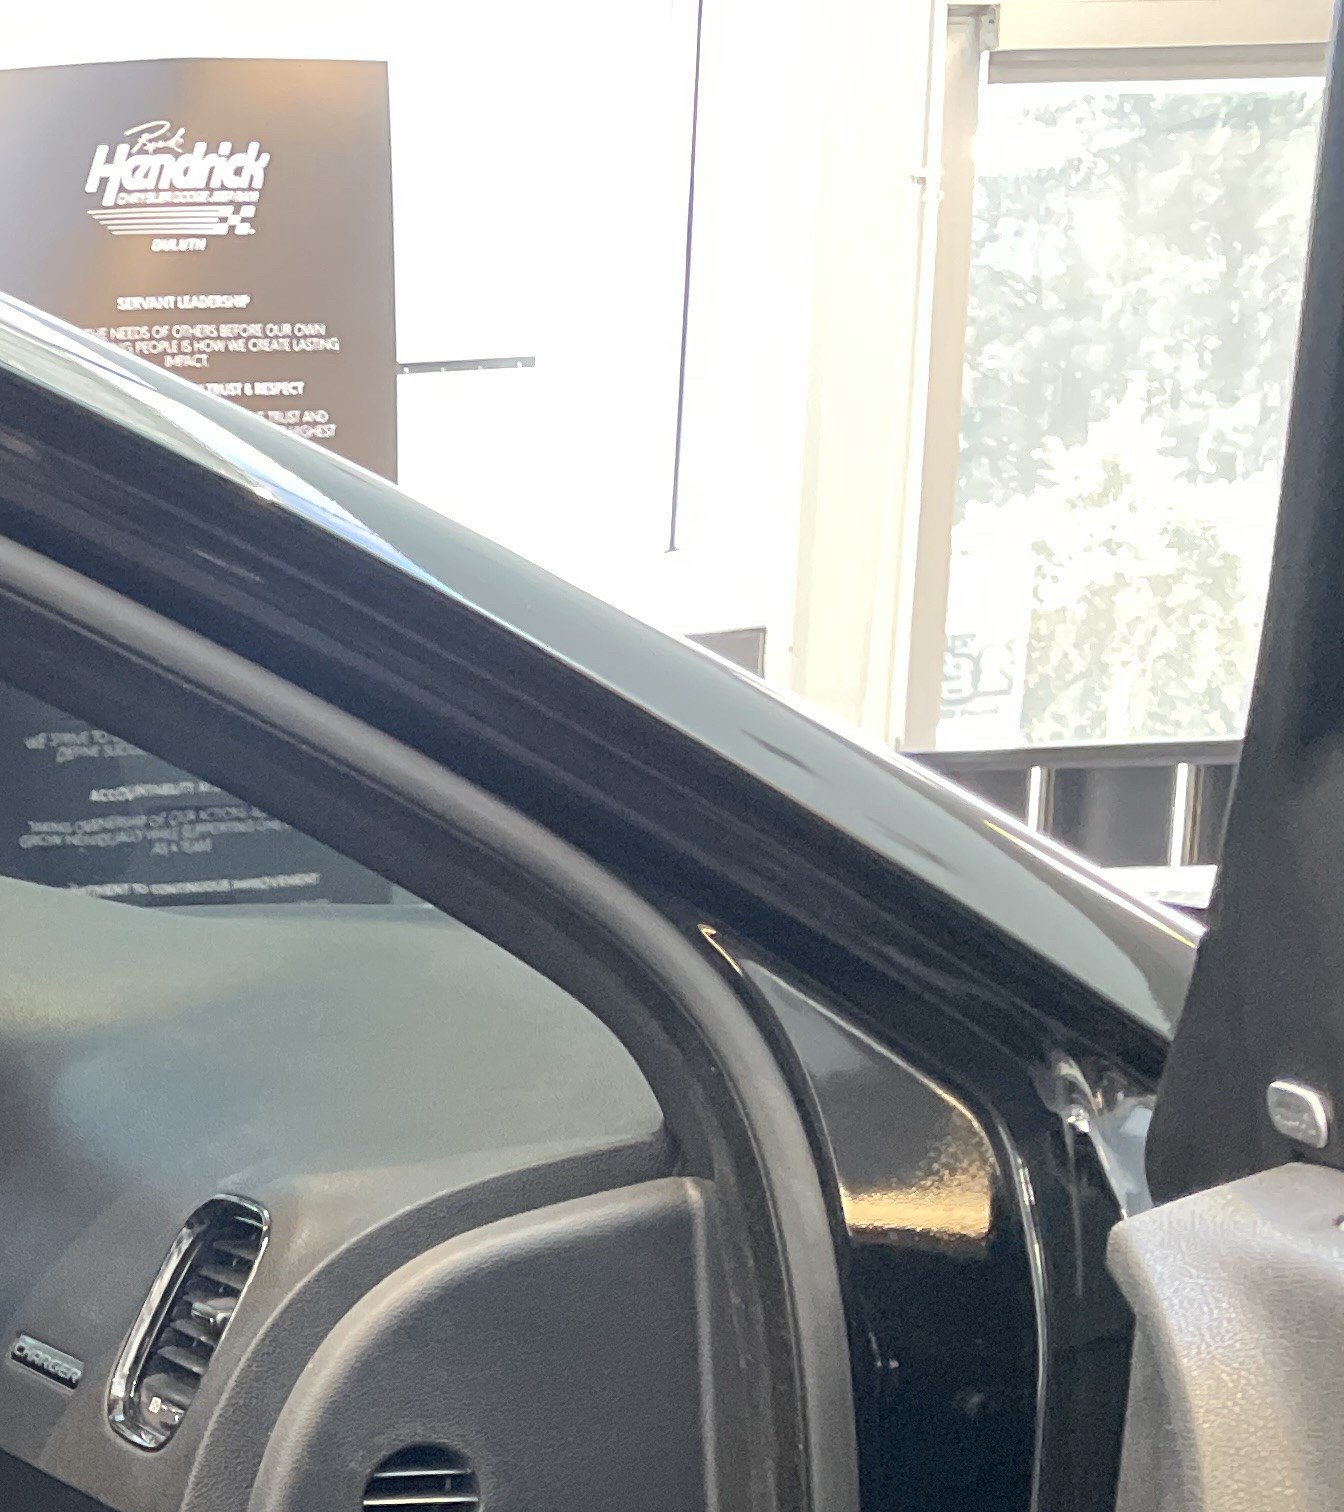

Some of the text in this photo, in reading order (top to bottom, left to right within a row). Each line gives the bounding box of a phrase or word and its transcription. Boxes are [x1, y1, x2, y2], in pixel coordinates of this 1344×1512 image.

[85, 141, 271, 207] Hendrick
[117, 294, 251, 311] SERVANT LEADERSHIP
[110, 326, 151, 340] NEEDS
[151, 325, 170, 339] OF
[171, 324, 218, 339] OTHERS
[219, 323, 264, 338] BEFORE
[265, 323, 292, 337] OUR
[294, 322, 326, 337] OWN
[135, 340, 179, 355] PEOPLE
[181, 339, 192, 353] IS
[193, 338, 226, 352] HOW
[227, 338, 247, 352] WE
[247, 338, 291, 352] CREATE
[292, 336, 340, 351] LASTING
[165, 354, 209, 368] IMPACT
[254, 381, 305, 396] RESPECT
[302, 409, 329, 423] AND
[13, 1341, 82, 1384] CHARGER
